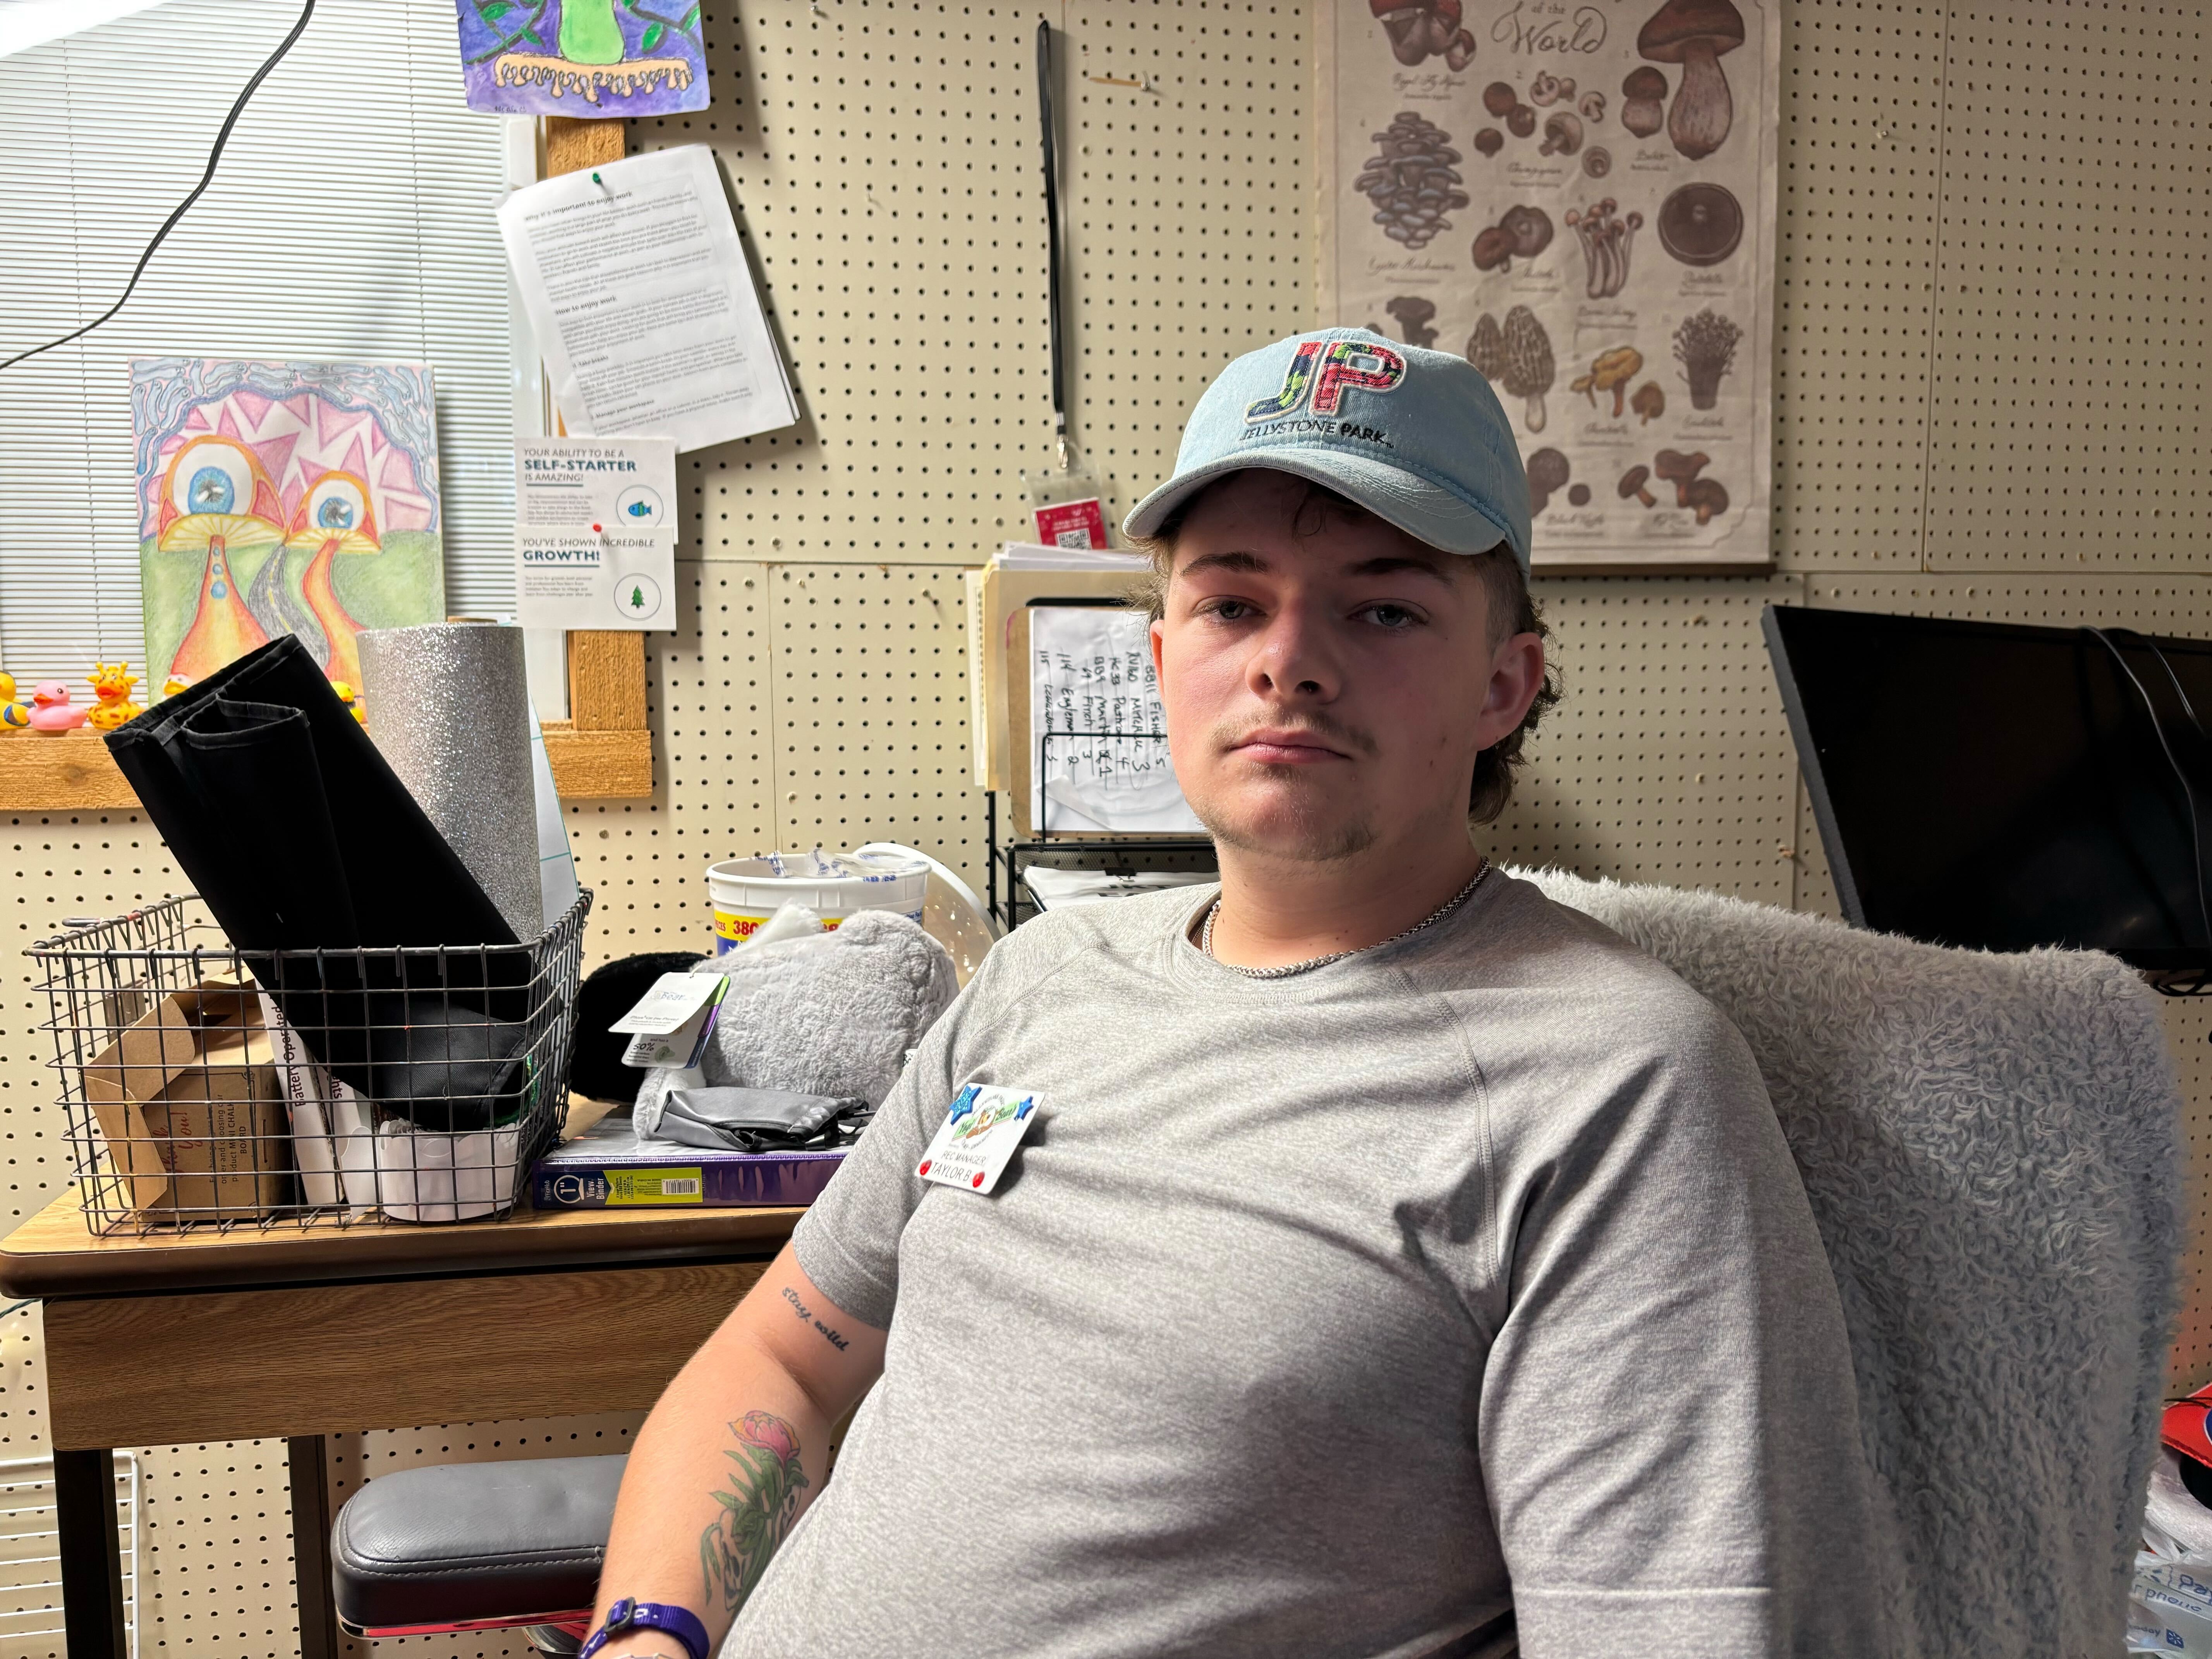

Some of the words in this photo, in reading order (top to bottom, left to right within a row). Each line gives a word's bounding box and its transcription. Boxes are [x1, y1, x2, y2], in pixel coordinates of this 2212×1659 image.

[1490, 1, 1607, 55] World
[552, 201, 586, 215] important
[596, 194, 615, 206] enjoy
[615, 190, 633, 200] work
[554, 306, 571, 315] How
[579, 299, 599, 311] enjoy
[599, 294, 617, 305] work
[1244, 341, 1407, 425] JP
[1240, 420, 1337, 441] JELLYSTONE
[524, 448, 550, 457] YOUR
[552, 448, 587, 457] ABILITY
[589, 449, 601, 458] TO
[605, 449, 615, 458] BE
[619, 449, 624, 457] A
[524, 459, 637, 471] SELF-STARTER
[535, 473, 584, 481] AMAZING!
[523, 538, 555, 547] YOU'VE
[558, 538, 596, 548] SHOWN
[600, 539, 654, 548] INCREDIBLE
[523, 550, 600, 561] GROWTH!
[1083, 696, 1096, 726] Finch
[1068, 756, 1079, 765] 2
[1082, 750, 1092, 759] 3
[1115, 757, 1129, 769] 4
[1132, 760, 1150, 771] 3
[633, 1042, 655, 1051] 50%
[290, 1065, 306, 1107] Battery
[217, 1108, 225, 1144] coosing
[228, 1130, 236, 1149] MNI
[942, 1150, 957, 1160] REC
[954, 1152, 986, 1164] MANAGER
[931, 1162, 963, 1180] TAYLOR
[587, 1181, 595, 1197] View
[596, 1178, 605, 1199] Binder
[782, 1287, 811, 1322] stay
